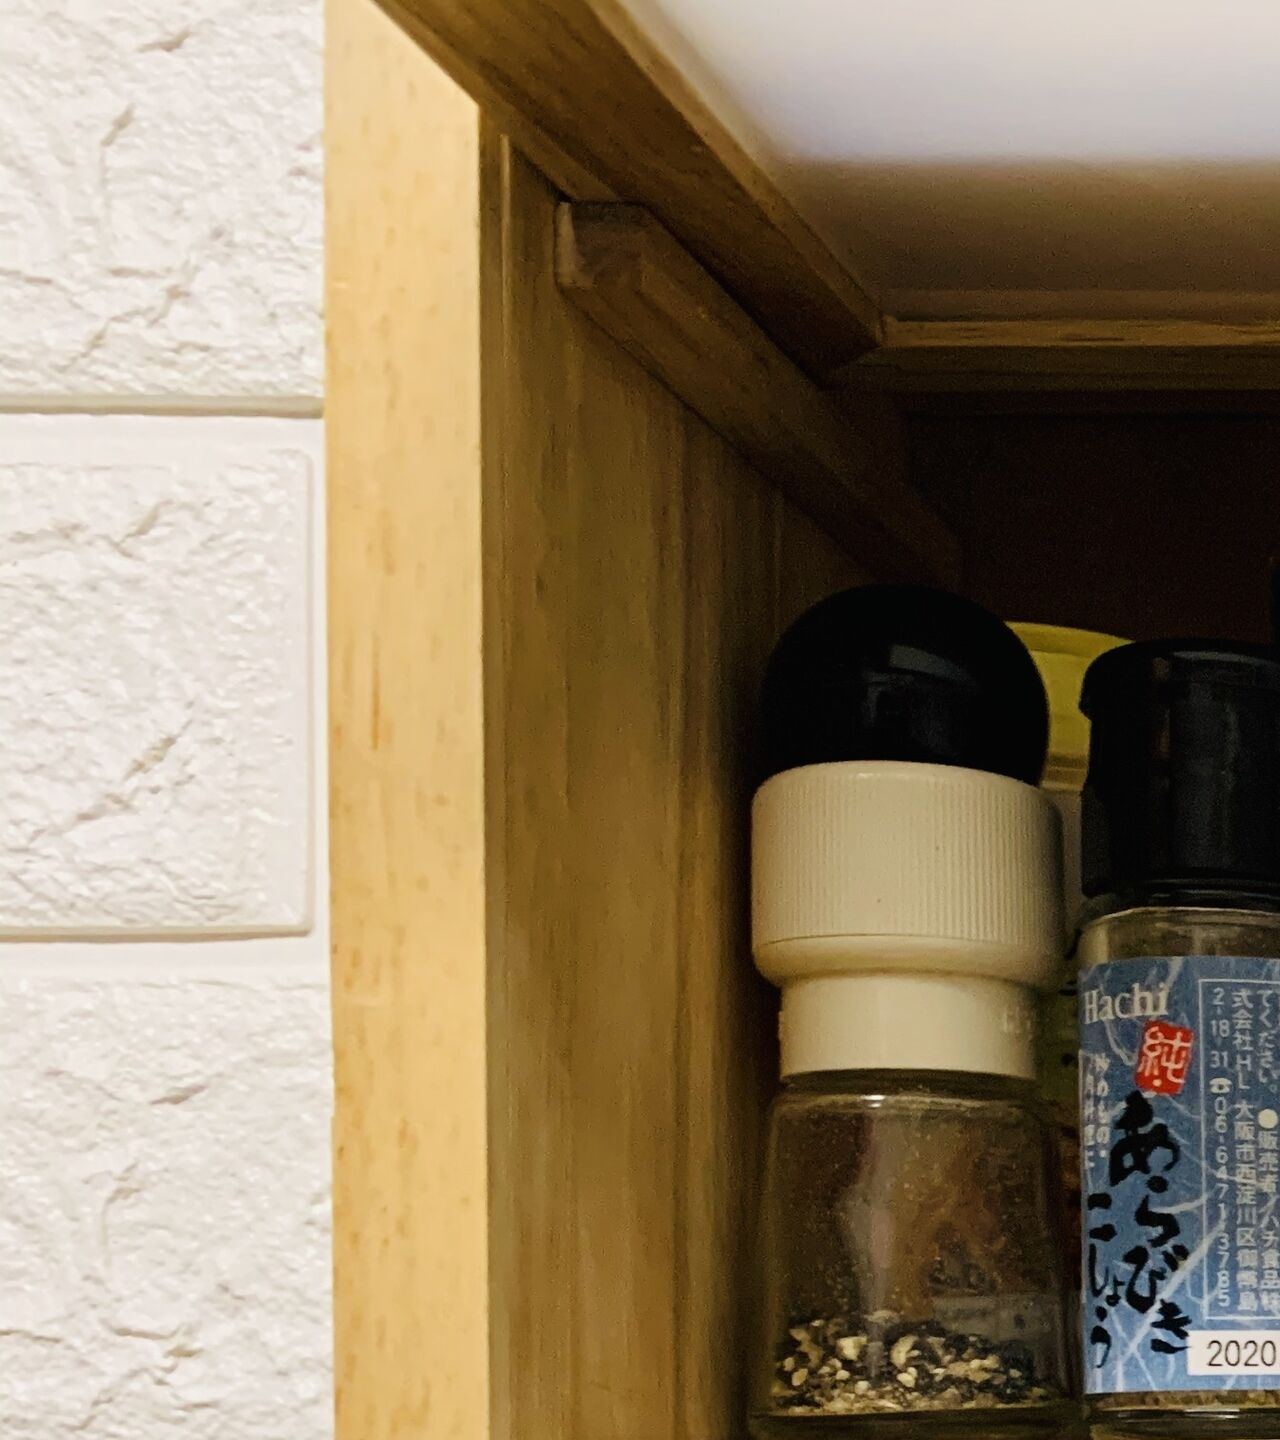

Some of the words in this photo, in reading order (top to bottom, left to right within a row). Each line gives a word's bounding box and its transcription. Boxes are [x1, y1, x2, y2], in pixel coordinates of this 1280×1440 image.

[1084, 982, 1168, 1024] Hachi
[1087, 1193, 1125, 1368] こしょう
[1110, 1090, 1192, 1354] あらびき
